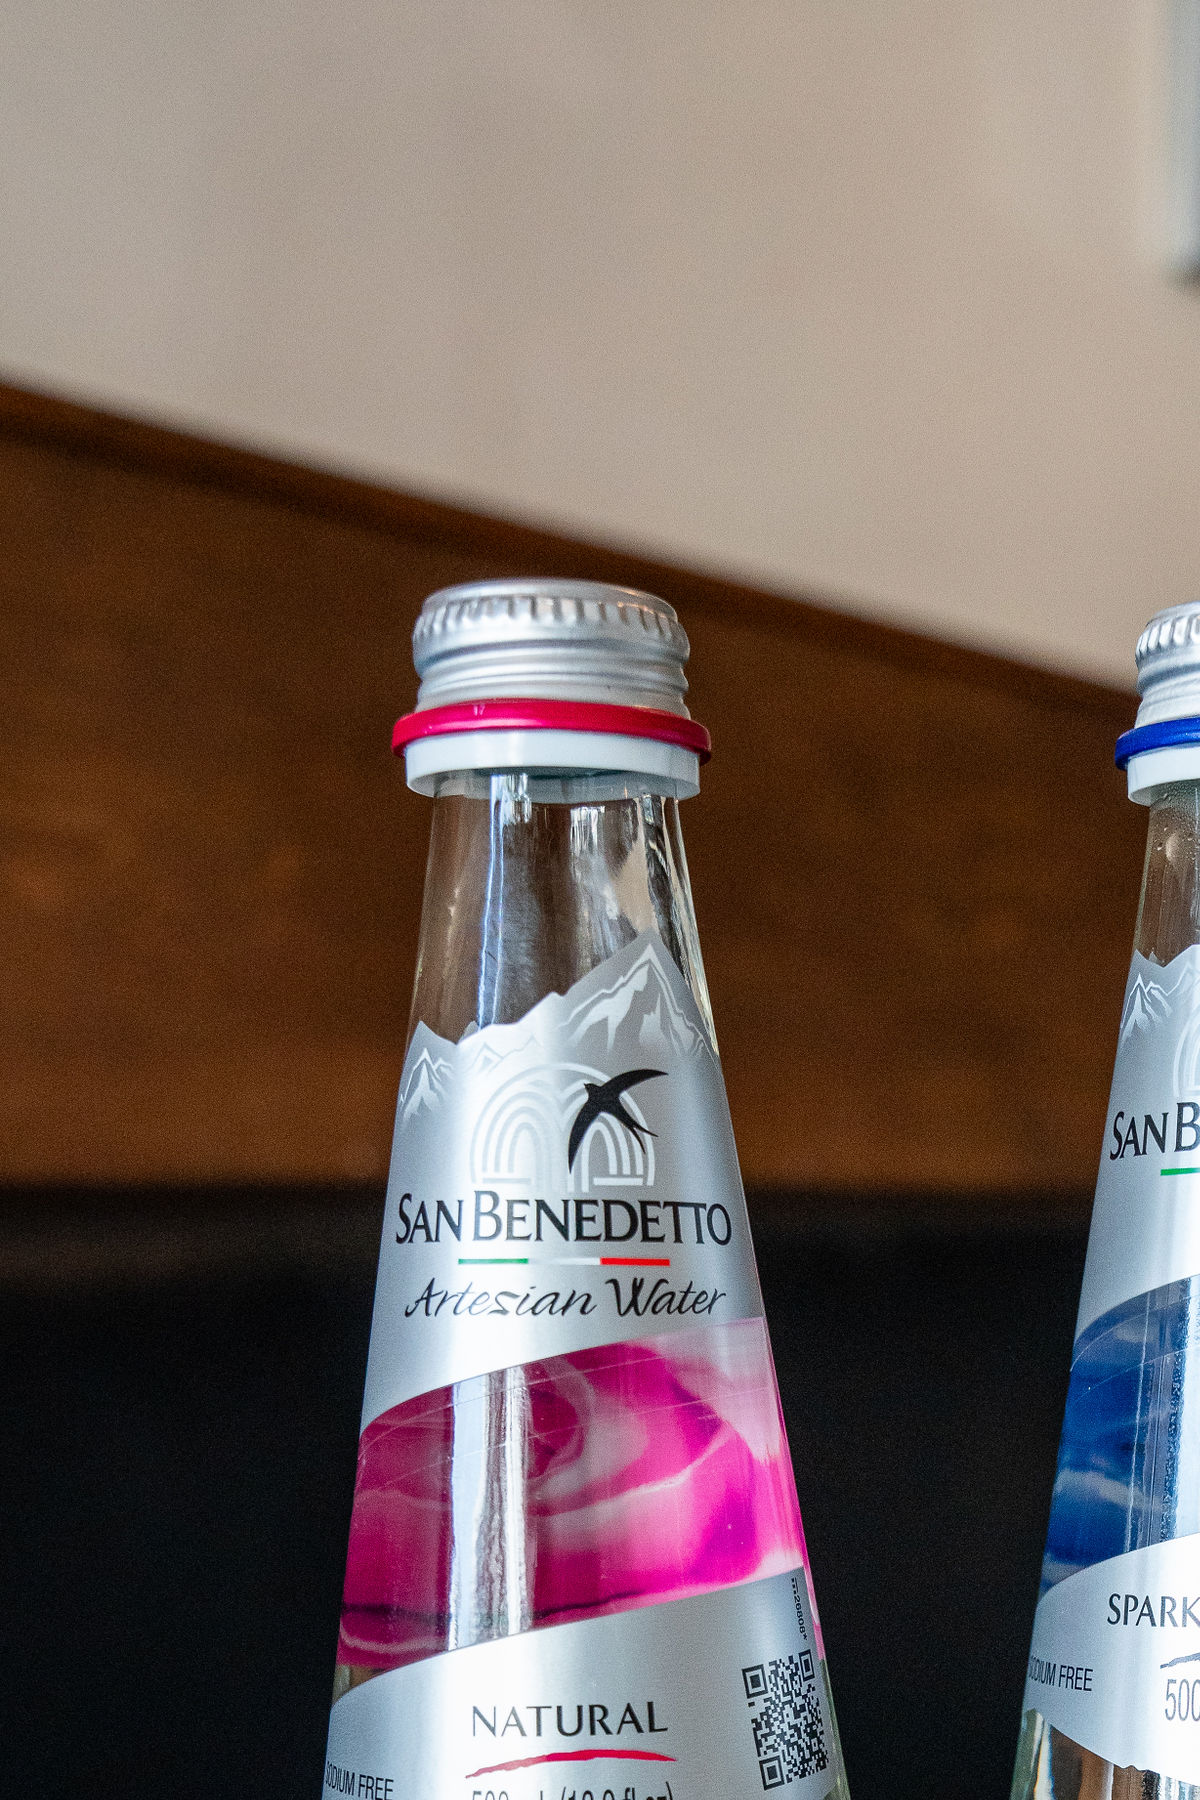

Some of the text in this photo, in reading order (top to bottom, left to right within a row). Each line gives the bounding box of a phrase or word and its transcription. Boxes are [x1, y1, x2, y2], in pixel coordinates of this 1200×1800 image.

[1110, 1110, 1169, 1161] SAN
[395, 1190, 732, 1247] SAN BENEDETTO
[404, 1277, 727, 1317] Artesian Water
[1058, 1664, 1093, 1692] FREE
[472, 1701, 669, 1738] NATURAL
